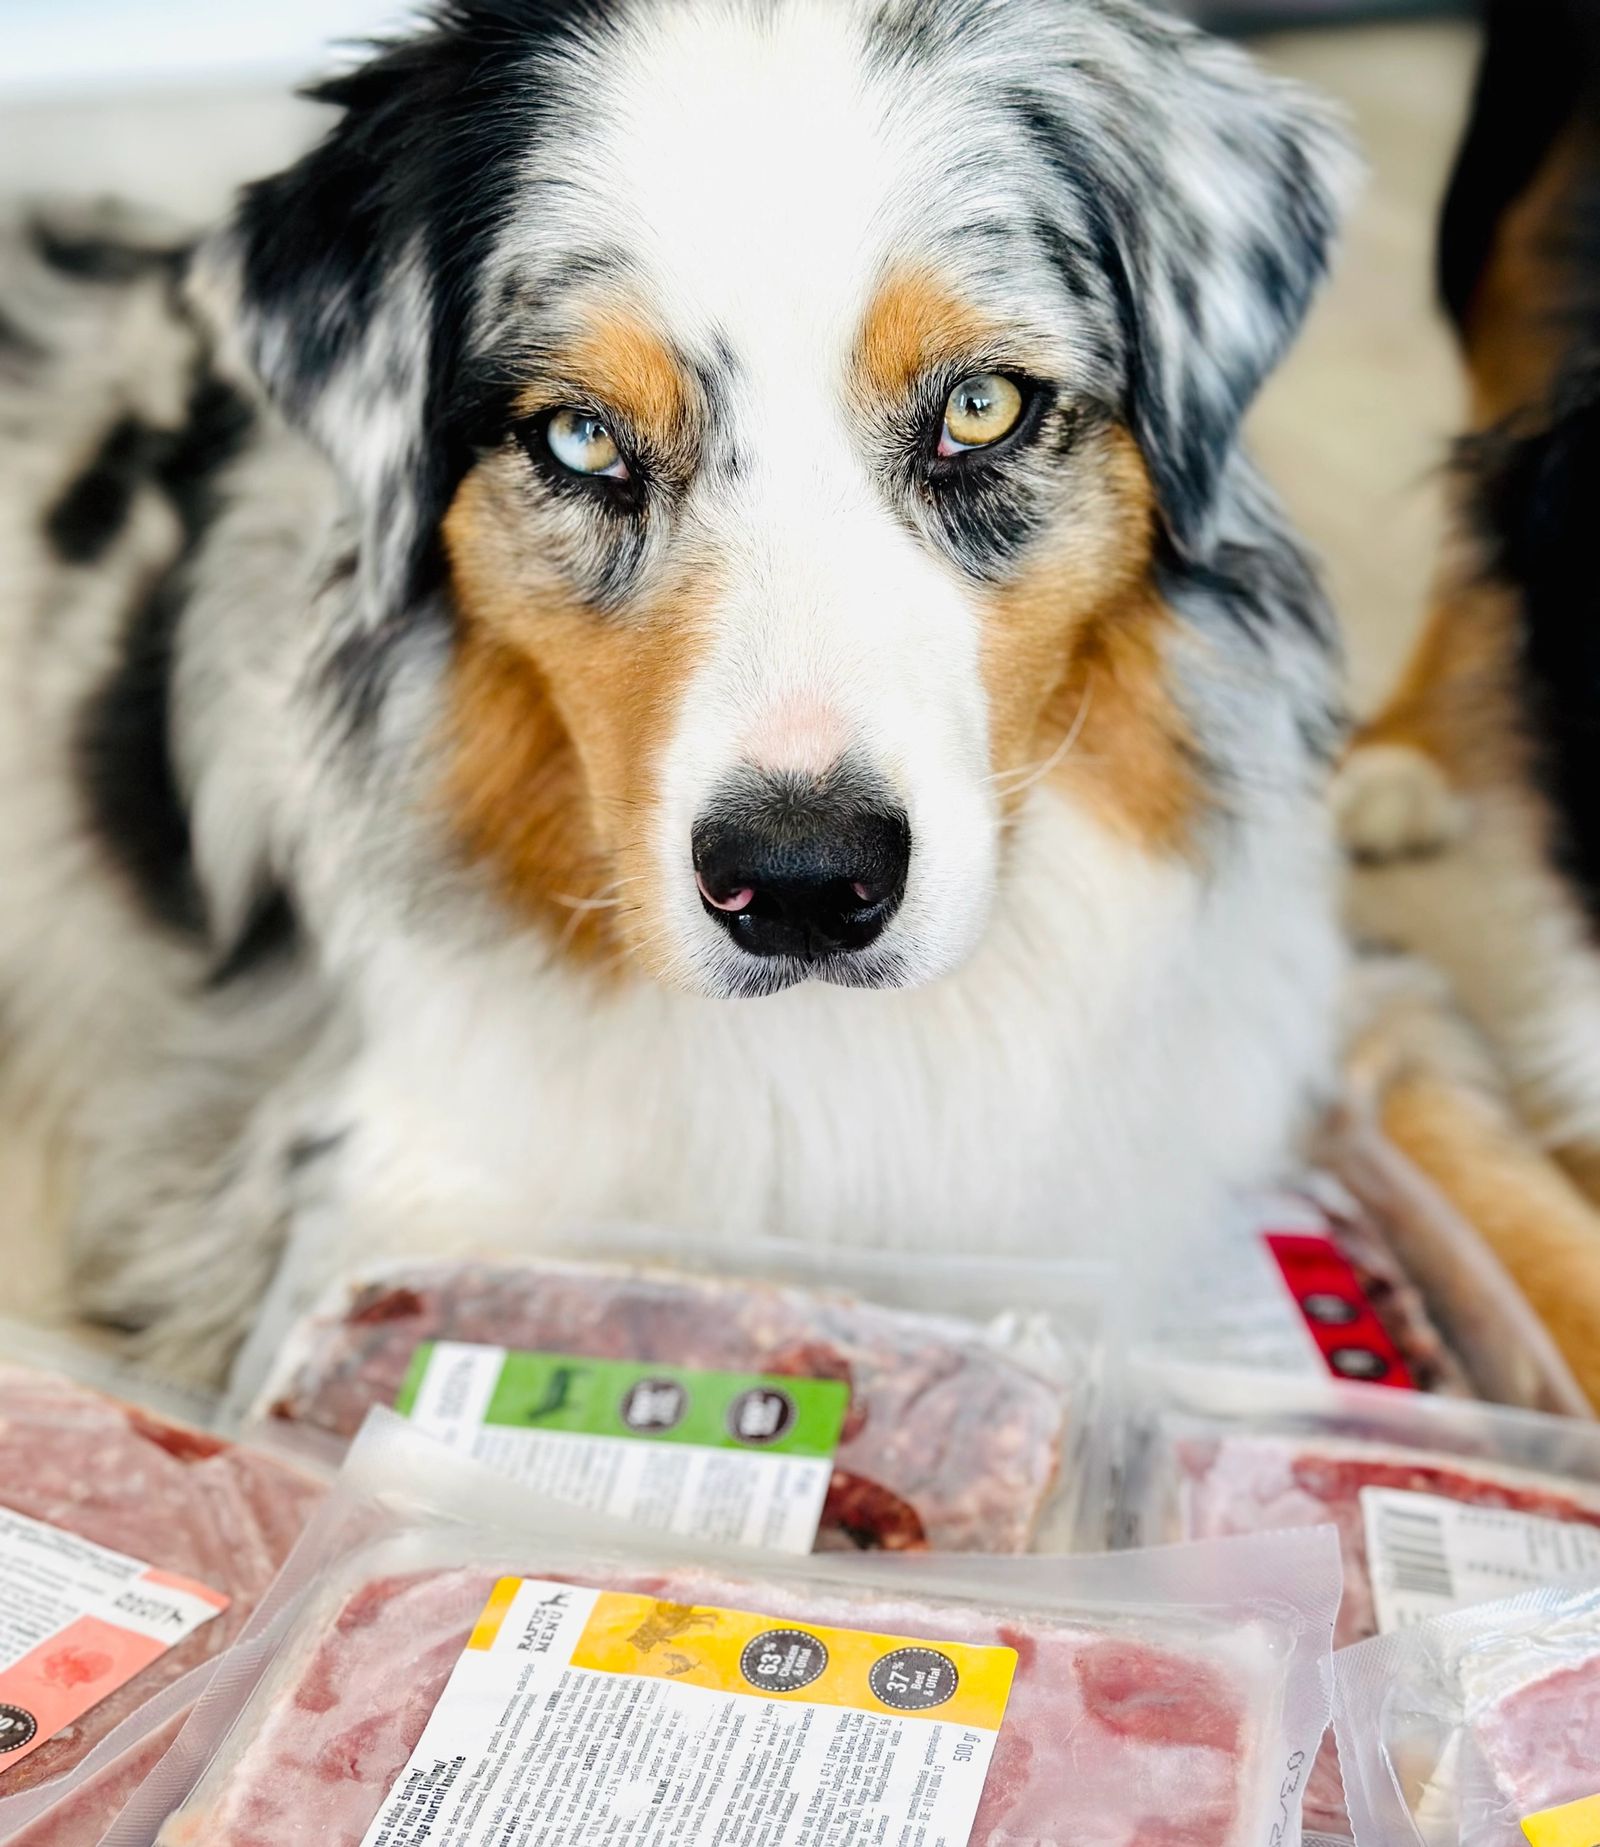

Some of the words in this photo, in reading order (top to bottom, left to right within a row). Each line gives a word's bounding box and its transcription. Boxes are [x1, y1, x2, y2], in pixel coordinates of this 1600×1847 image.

[517, 1609, 546, 1650] RAFUS
[535, 1612, 562, 1653] MENU
[779, 1645, 799, 1677] Chicken
[796, 1649, 811, 1668] Offal
[911, 1671, 926, 1690] Beef
[926, 1668, 941, 1688] Offal
[963, 1732, 981, 1743] gr
[582, 1743, 602, 1771] SASTĀVS:
[953, 1744, 974, 1762] 500
[421, 1788, 448, 1823] toortoit
[437, 1756, 466, 1787] koertele
[416, 1794, 429, 1805] un
[402, 1807, 422, 1827] vistu
[504, 1815, 520, 1834] dalys:
[397, 1828, 409, 1838] ar
